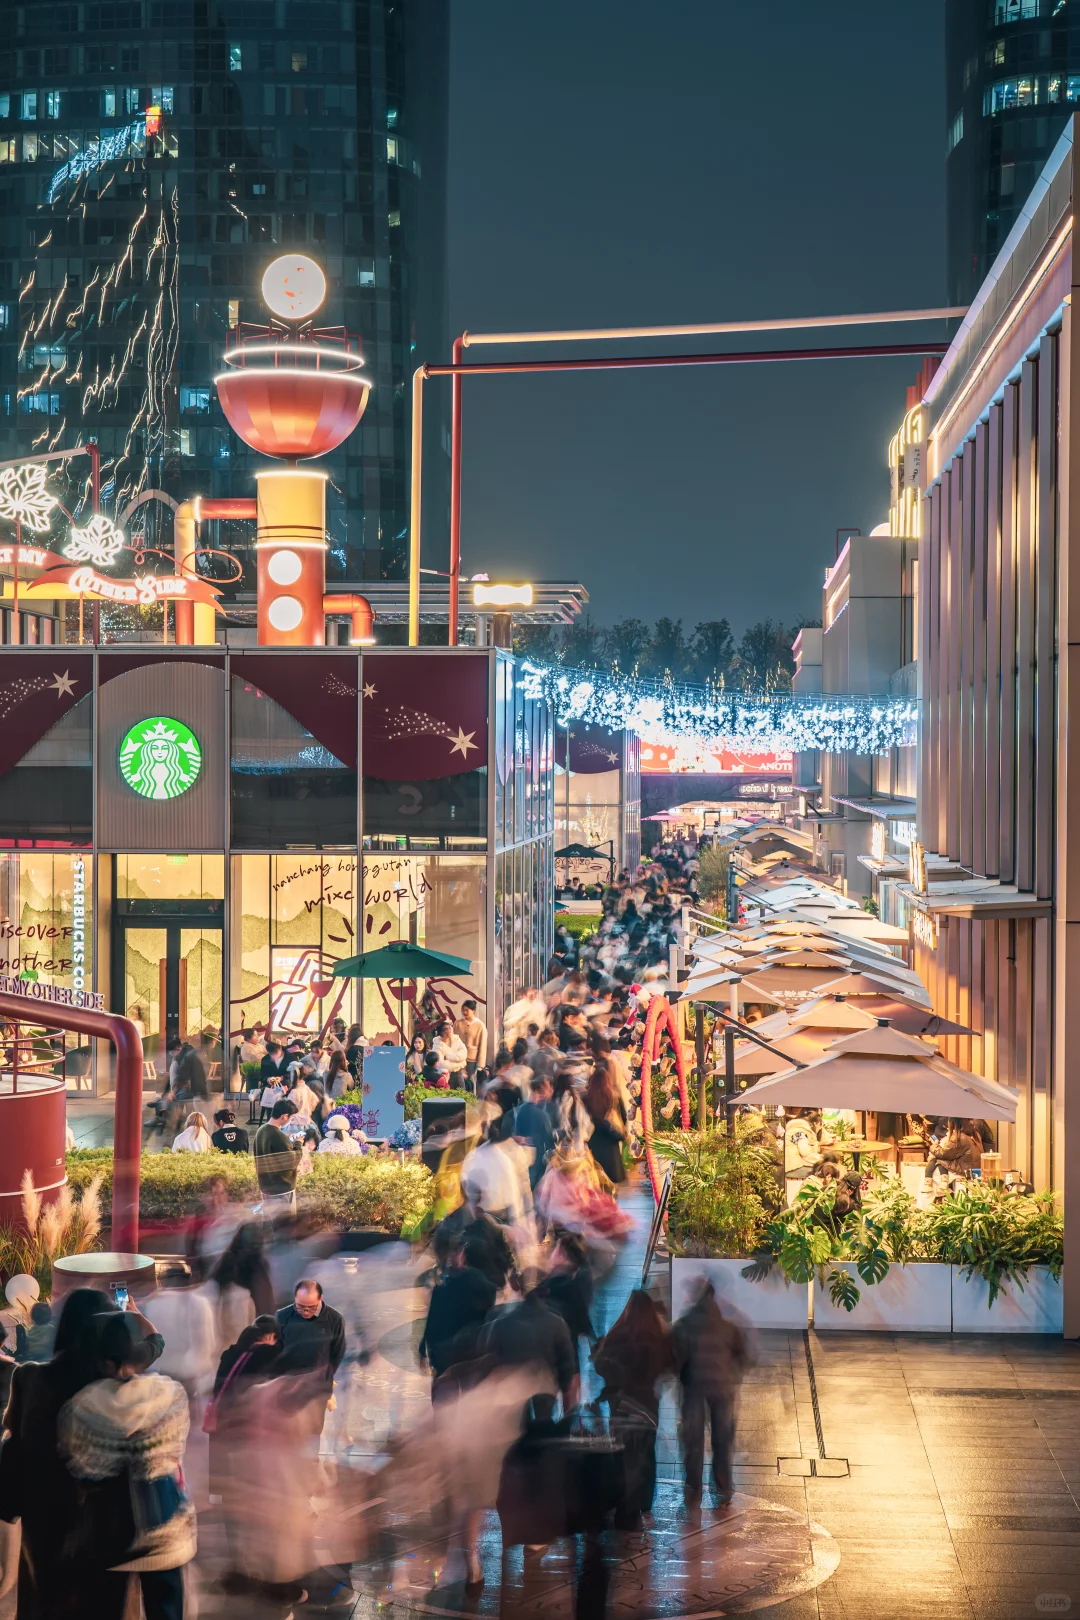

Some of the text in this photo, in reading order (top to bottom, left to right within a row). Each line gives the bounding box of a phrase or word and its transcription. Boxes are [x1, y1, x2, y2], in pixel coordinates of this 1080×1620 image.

[18, 548, 47, 566] MY
[272, 862, 333, 892] nanchang
[73, 860, 85, 963] STARBUCKS
[304, 885, 355, 913] mixc
[12, 979, 30, 998] MY
[32, 981, 74, 1005] OTHER
[76, 990, 105, 1011] SIDE
